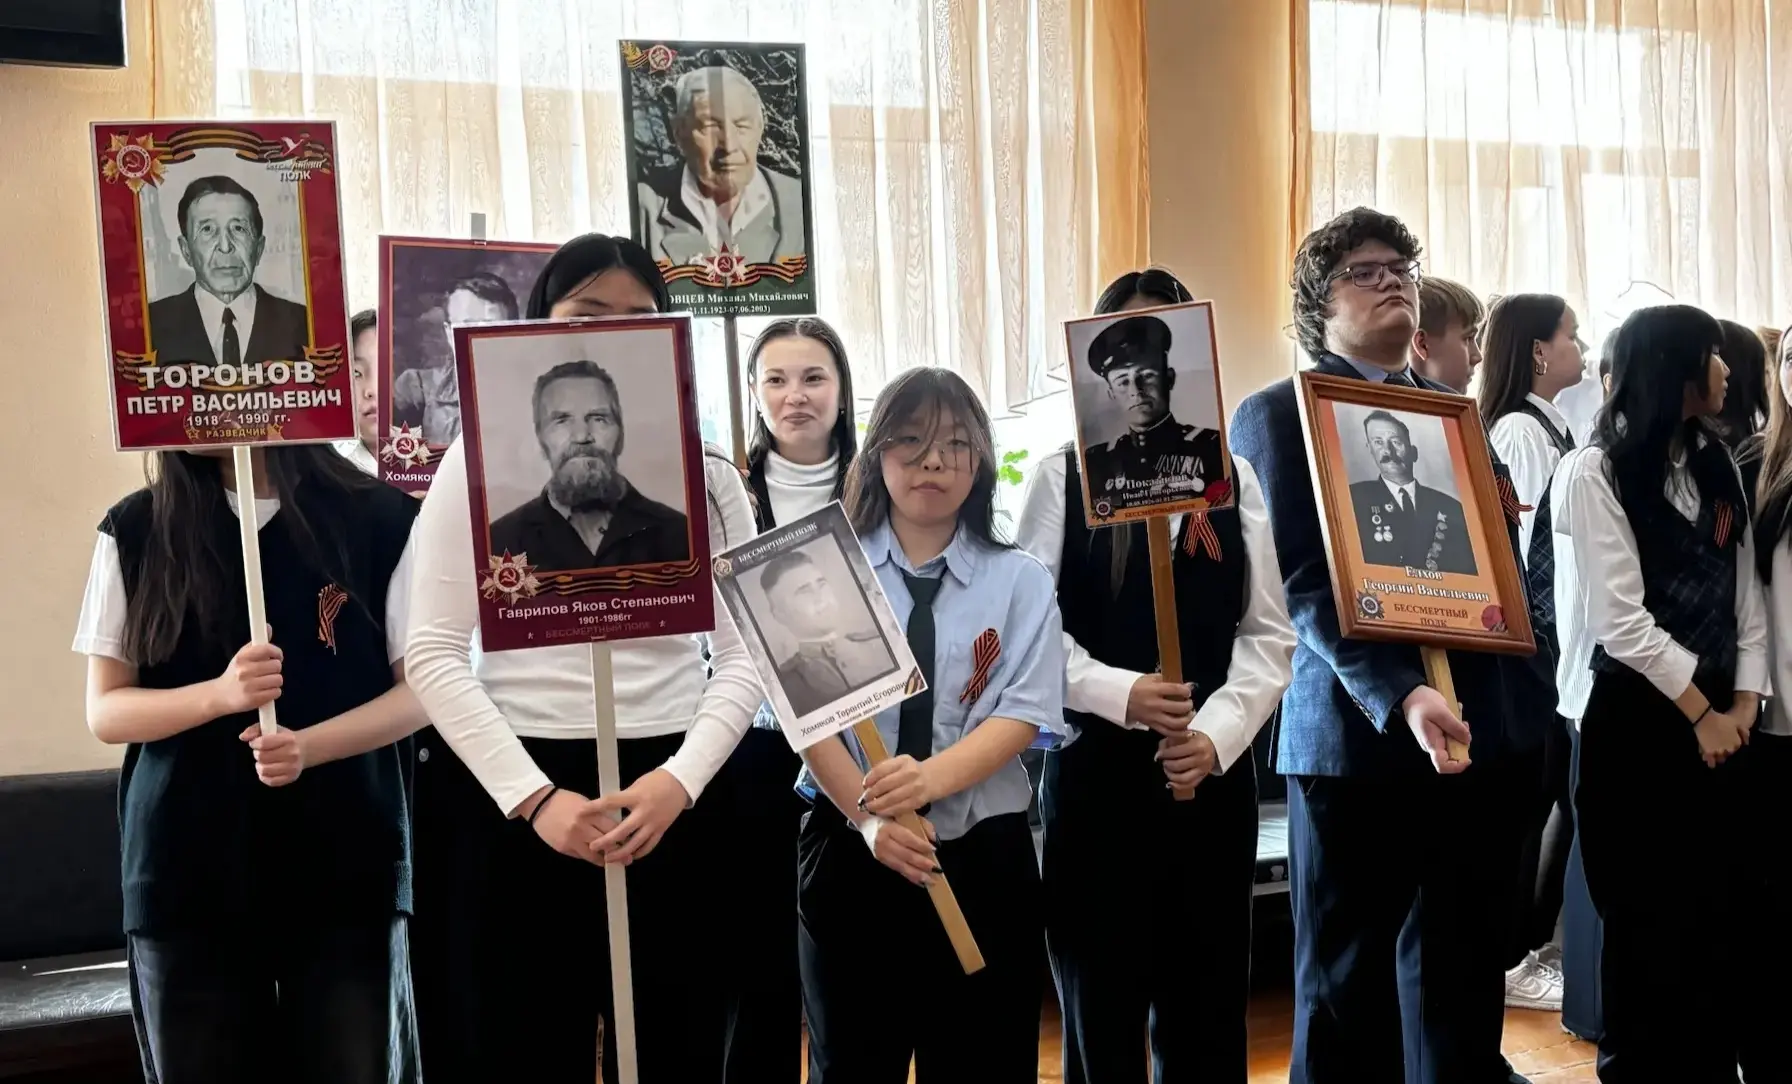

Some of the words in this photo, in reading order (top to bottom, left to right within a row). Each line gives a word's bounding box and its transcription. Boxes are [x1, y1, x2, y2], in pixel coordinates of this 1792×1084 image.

[280, 170, 311, 182] ПОЛК
[707, 294, 746, 303] Михаил
[749, 293, 809, 302] Михайлович
[139, 361, 316, 389] ТОРОНОВ
[127, 396, 184, 414] ПЕТР
[192, 389, 341, 412] ВАСИЛЬЕВИЧ
[187, 415, 219, 426] 1918
[237, 413, 270, 424] 1990
[274, 413, 291, 424] гг.
[206, 428, 266, 438] РАЗВЕДЧИК
[1405, 565, 1443, 580] Елхов
[1363, 578, 1414, 595] Георгий
[1417, 584, 1490, 602] Васильевич
[498, 605, 569, 620] Гаврилов
[572, 599, 607, 612] Яков
[611, 594, 695, 611] Степанович
[1394, 603, 1469, 619] БЕССМЕРТНЫЙ
[578, 614, 632, 625] 1901-1986гг
[1420, 617, 1448, 628] ПОЛК
[545, 623, 622, 639] БЕССМЕРТНЫЙ
[800, 715, 836, 737] Хомяков
